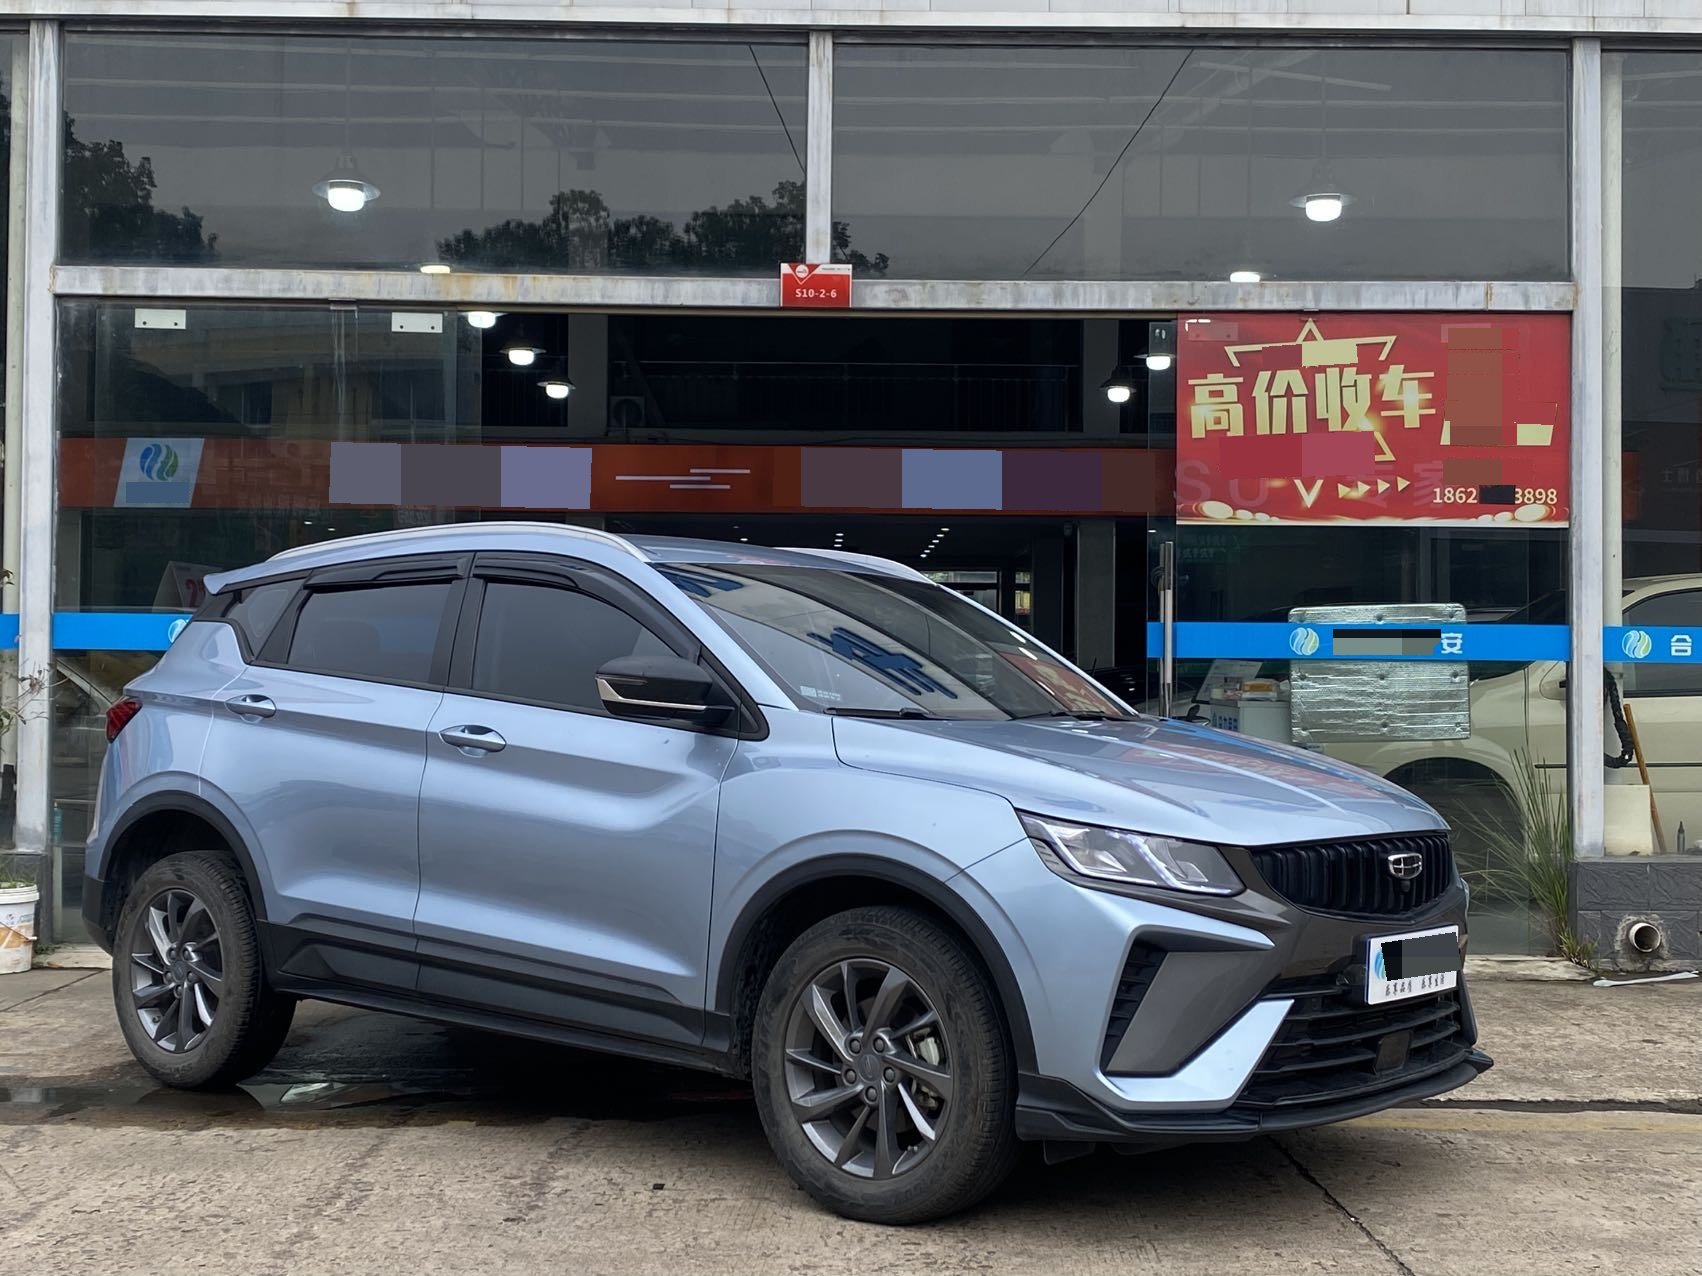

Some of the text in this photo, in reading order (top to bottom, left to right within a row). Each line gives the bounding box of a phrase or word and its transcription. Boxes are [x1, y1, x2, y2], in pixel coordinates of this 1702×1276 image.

[795, 288, 837, 298] S10-2-6
[1188, 364, 1436, 438] 高价收车
[1432, 487, 1557, 504] 18623898
